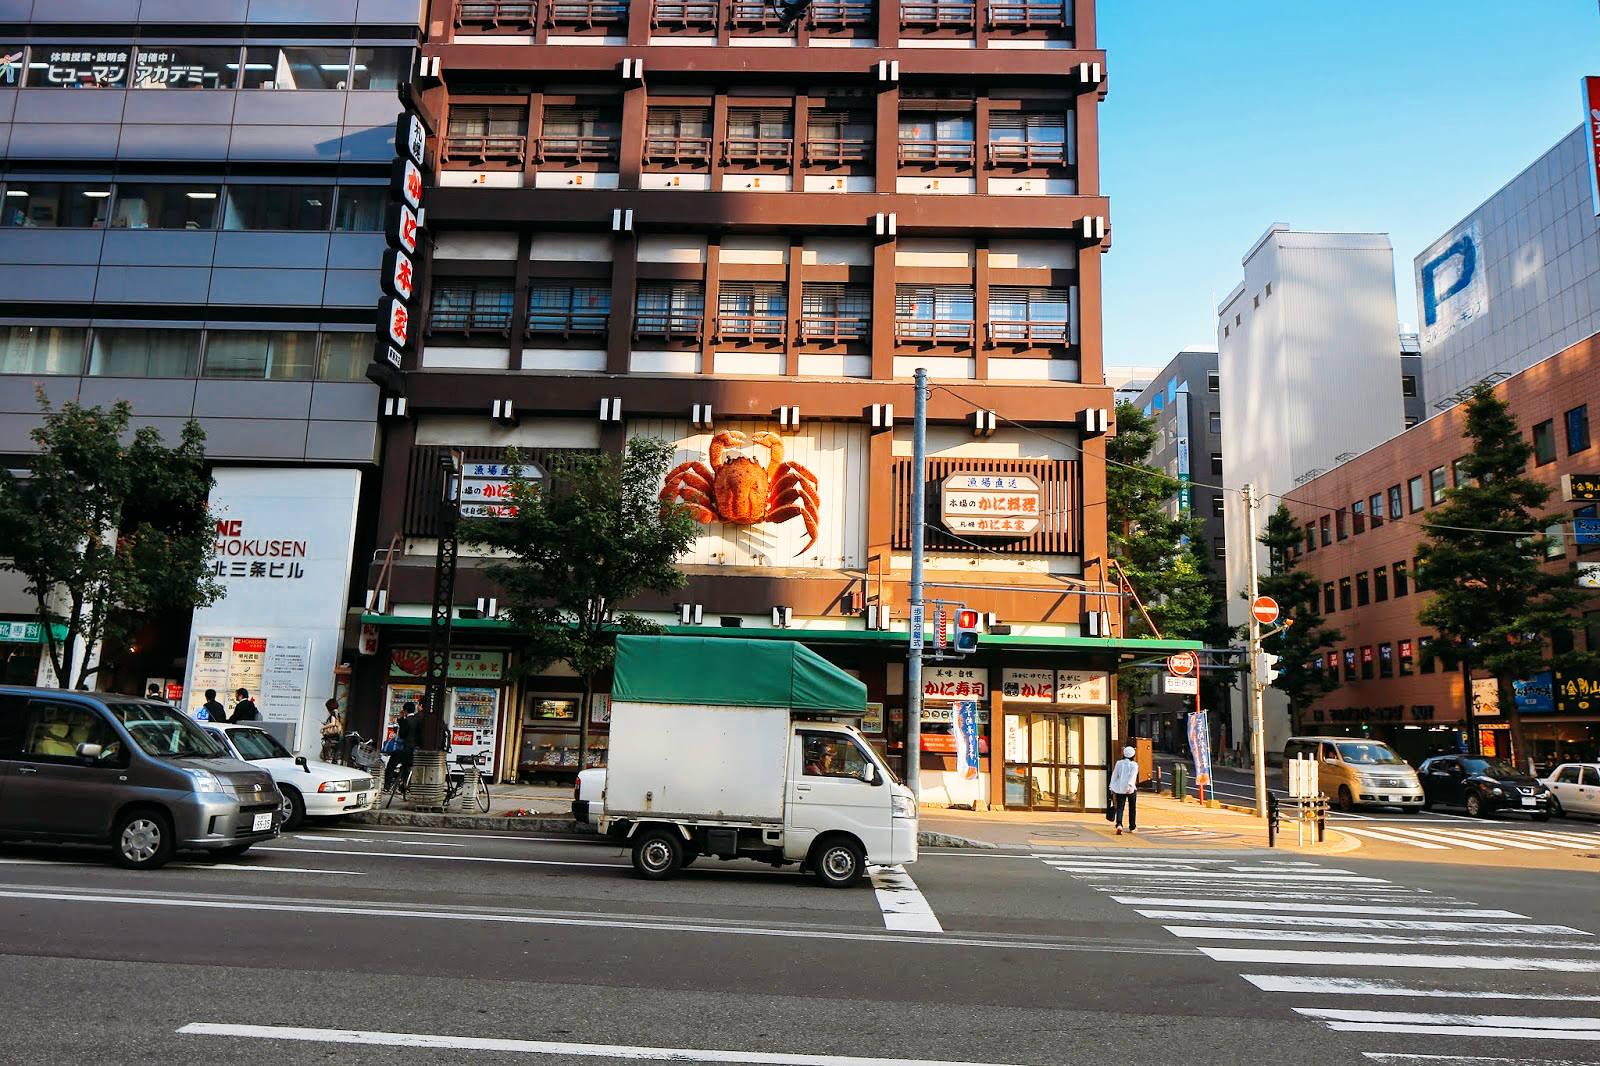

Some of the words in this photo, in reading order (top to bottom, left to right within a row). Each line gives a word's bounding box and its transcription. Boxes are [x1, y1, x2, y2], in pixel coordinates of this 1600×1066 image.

[48, 65, 125, 83] ヒューマン
[135, 65, 219, 83] アカデミー
[967, 477, 1017, 488] 漁場直送
[978, 497, 1037, 512] かに料理
[977, 519, 1026, 530] かに本家
[213, 539, 307, 558] HOKUSEN
[210, 560, 305, 579] 北三条ビル
[924, 680, 985, 697] かに寿司
[1021, 683, 1053, 698] かに
